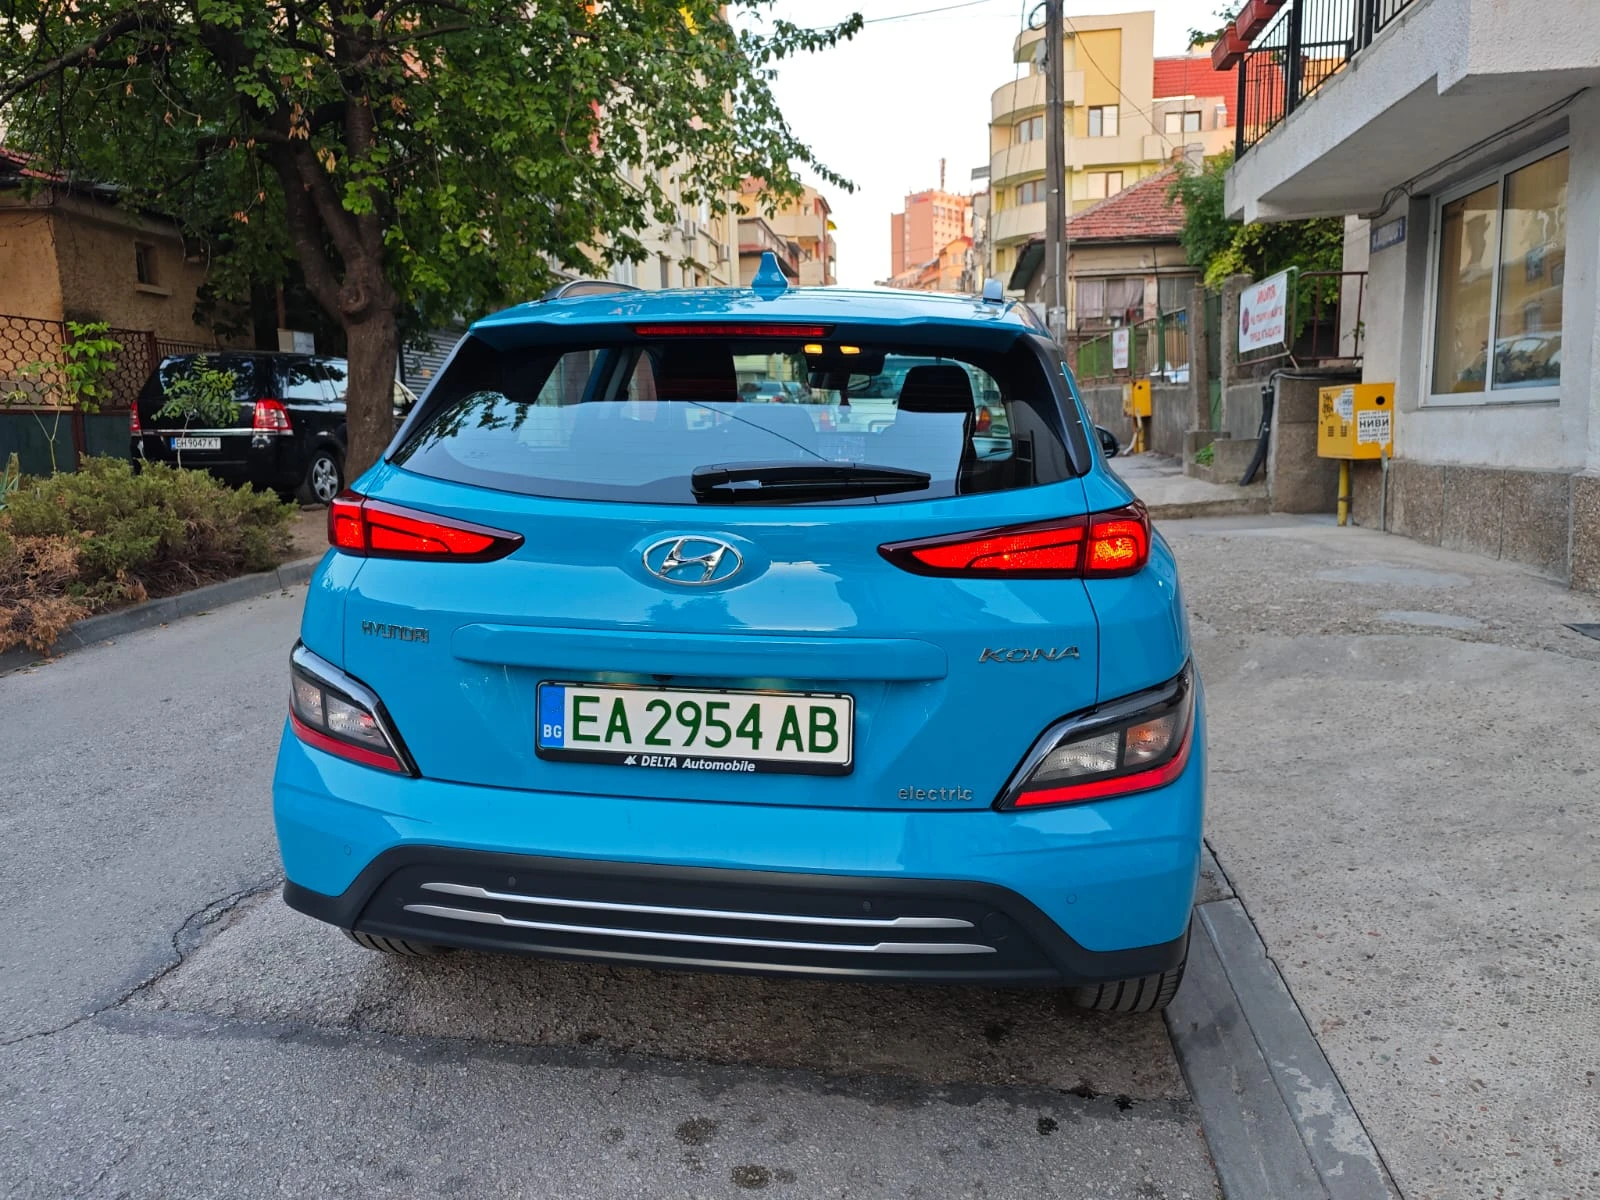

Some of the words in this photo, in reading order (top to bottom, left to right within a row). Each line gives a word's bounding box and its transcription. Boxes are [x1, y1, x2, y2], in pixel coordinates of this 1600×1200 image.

[1359, 419, 1389, 428] НИВИ
[361, 619, 430, 644] HYUNDAI
[979, 646, 1080, 663] KONA
[543, 724, 562, 739] BG
[572, 695, 632, 744] EA
[644, 698, 763, 750] 2954
[775, 704, 840, 754] AB
[641, 755, 678, 769] DELTA
[682, 759, 756, 773] Automobile
[898, 785, 973, 801] electric
